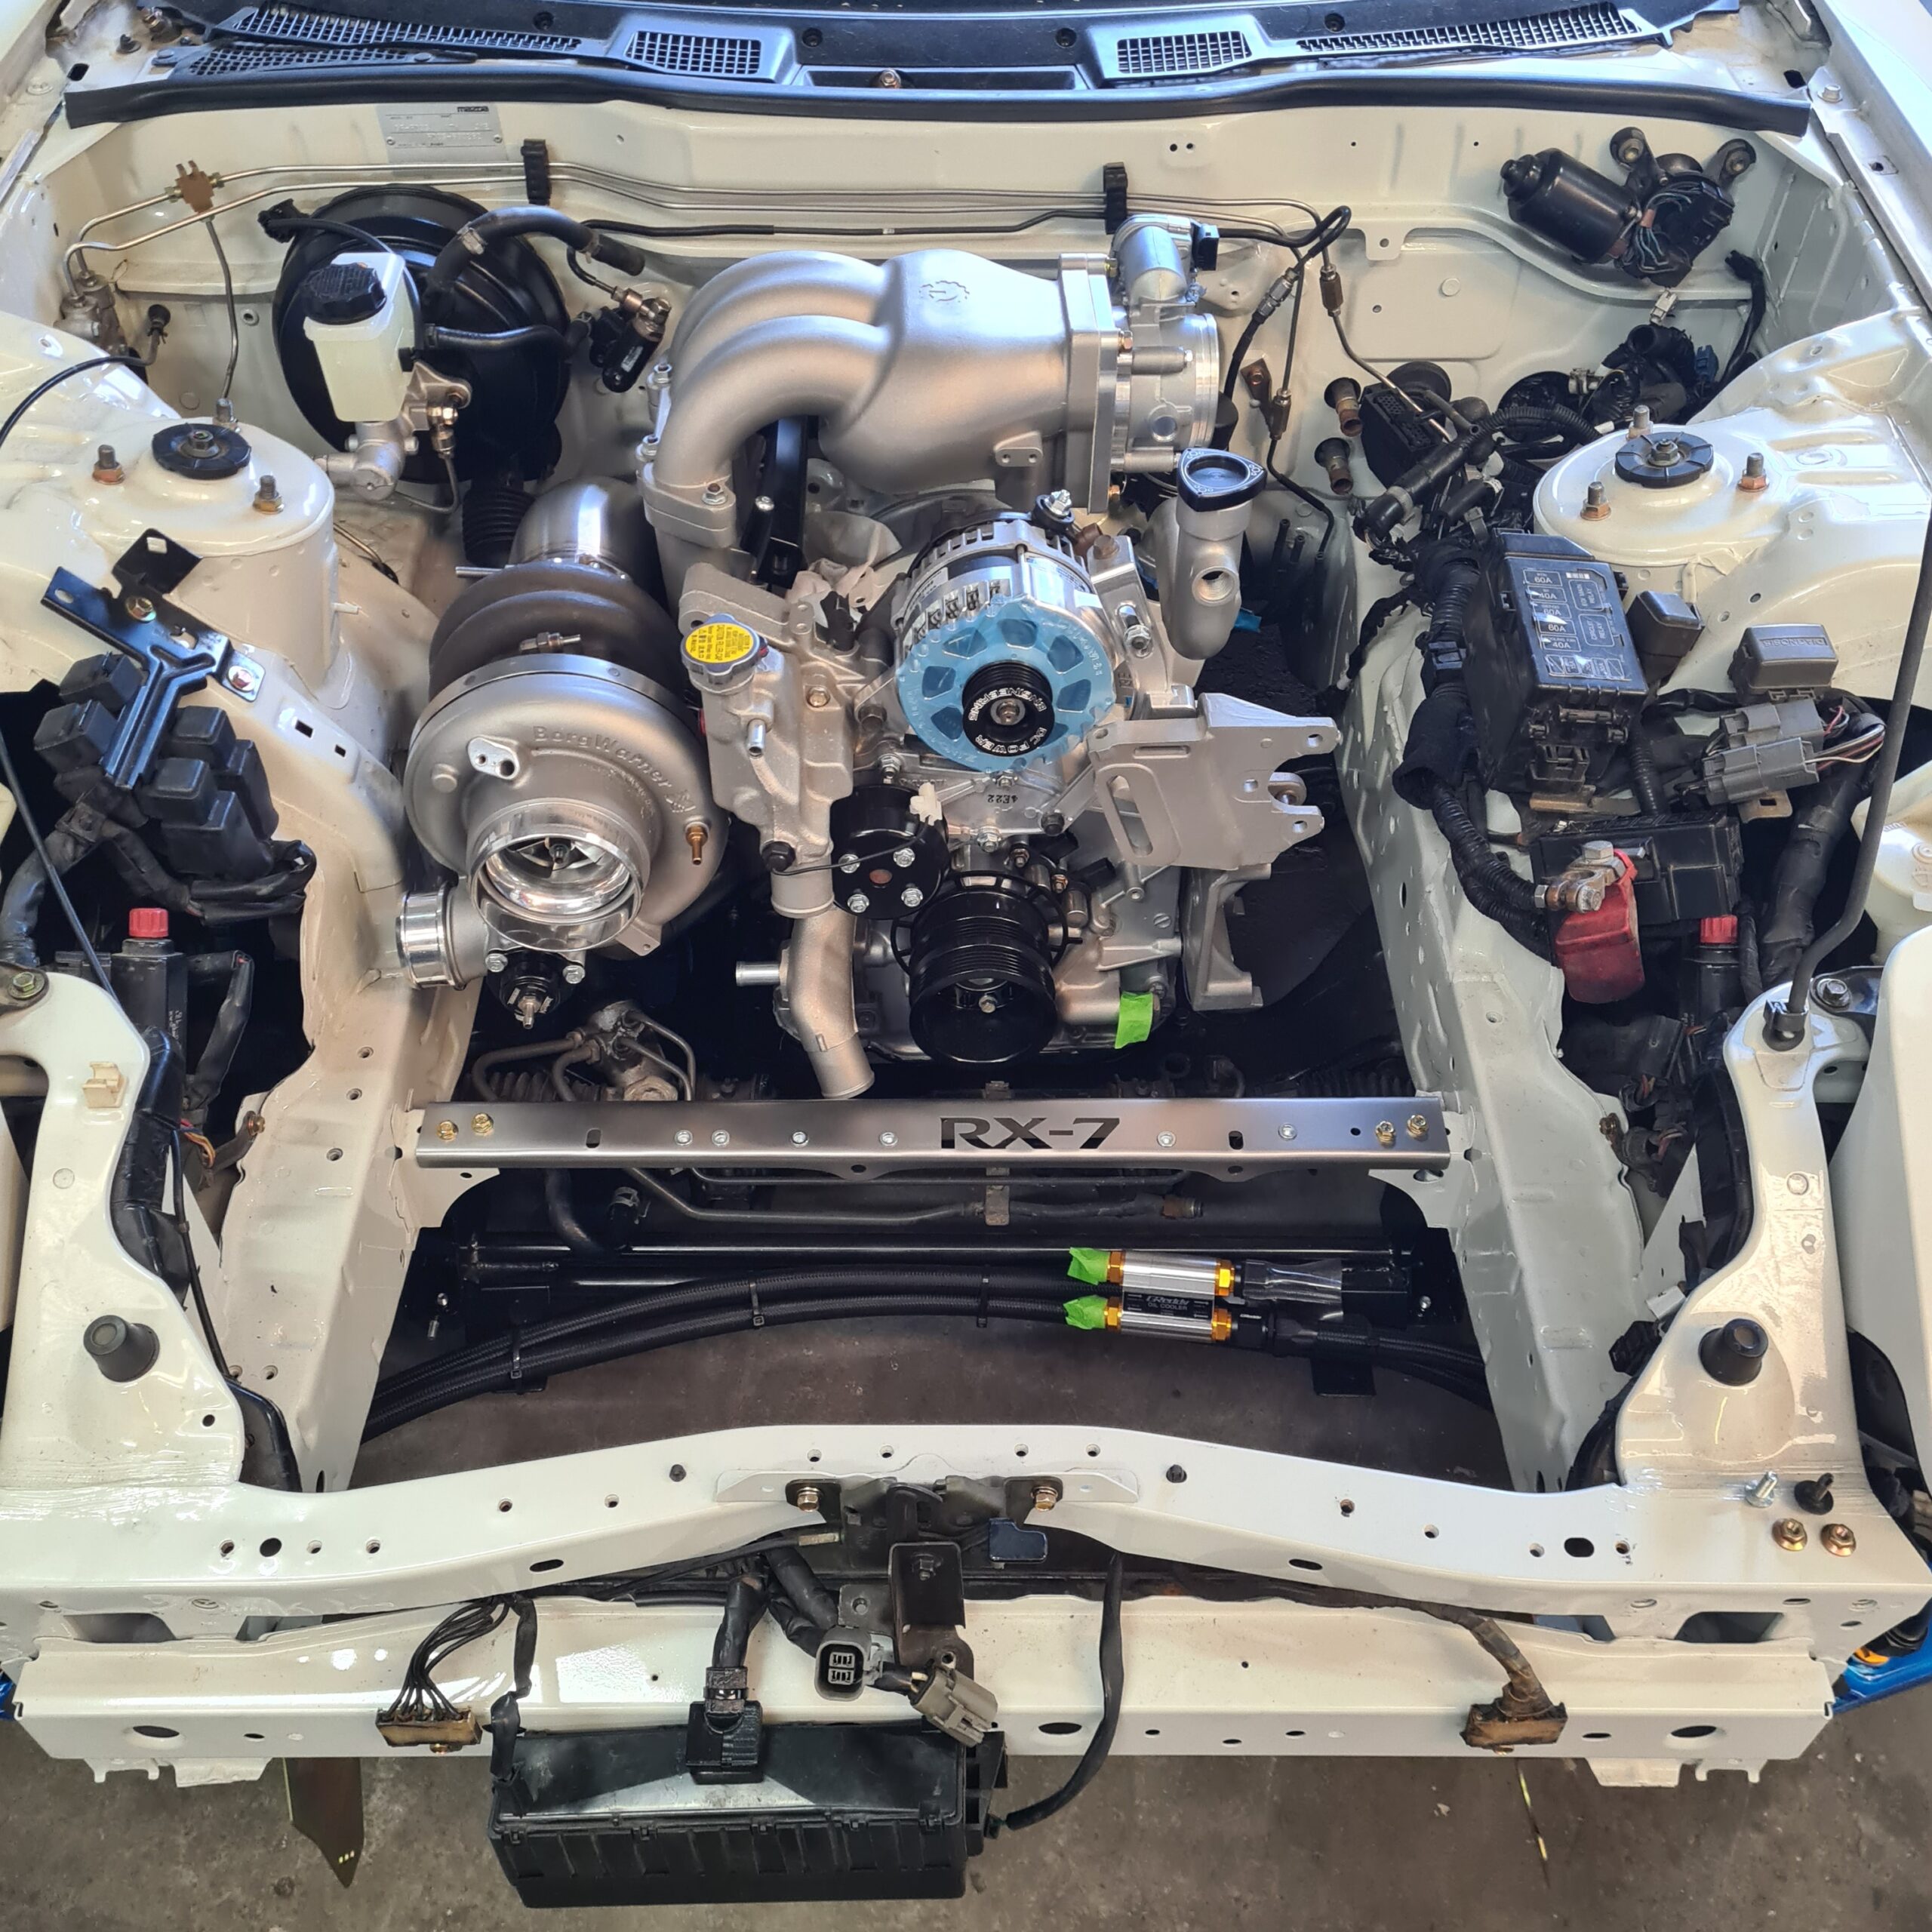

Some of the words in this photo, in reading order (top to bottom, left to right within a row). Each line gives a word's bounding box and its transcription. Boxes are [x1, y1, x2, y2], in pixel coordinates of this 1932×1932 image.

[1586, 587, 1595, 604] RELAY
[1597, 623, 1607, 639] RELAY
[1762, 638, 1826, 648] DIAGNOSIS
[974, 734, 1031, 755] POWER
[1029, 726, 1048, 746] DC
[532, 725, 673, 789] BorgWarner
[987, 794, 1019, 804] 4E22
[940, 1117, 1121, 1149] RX-7
[1160, 1303, 1188, 1311] COOLER
